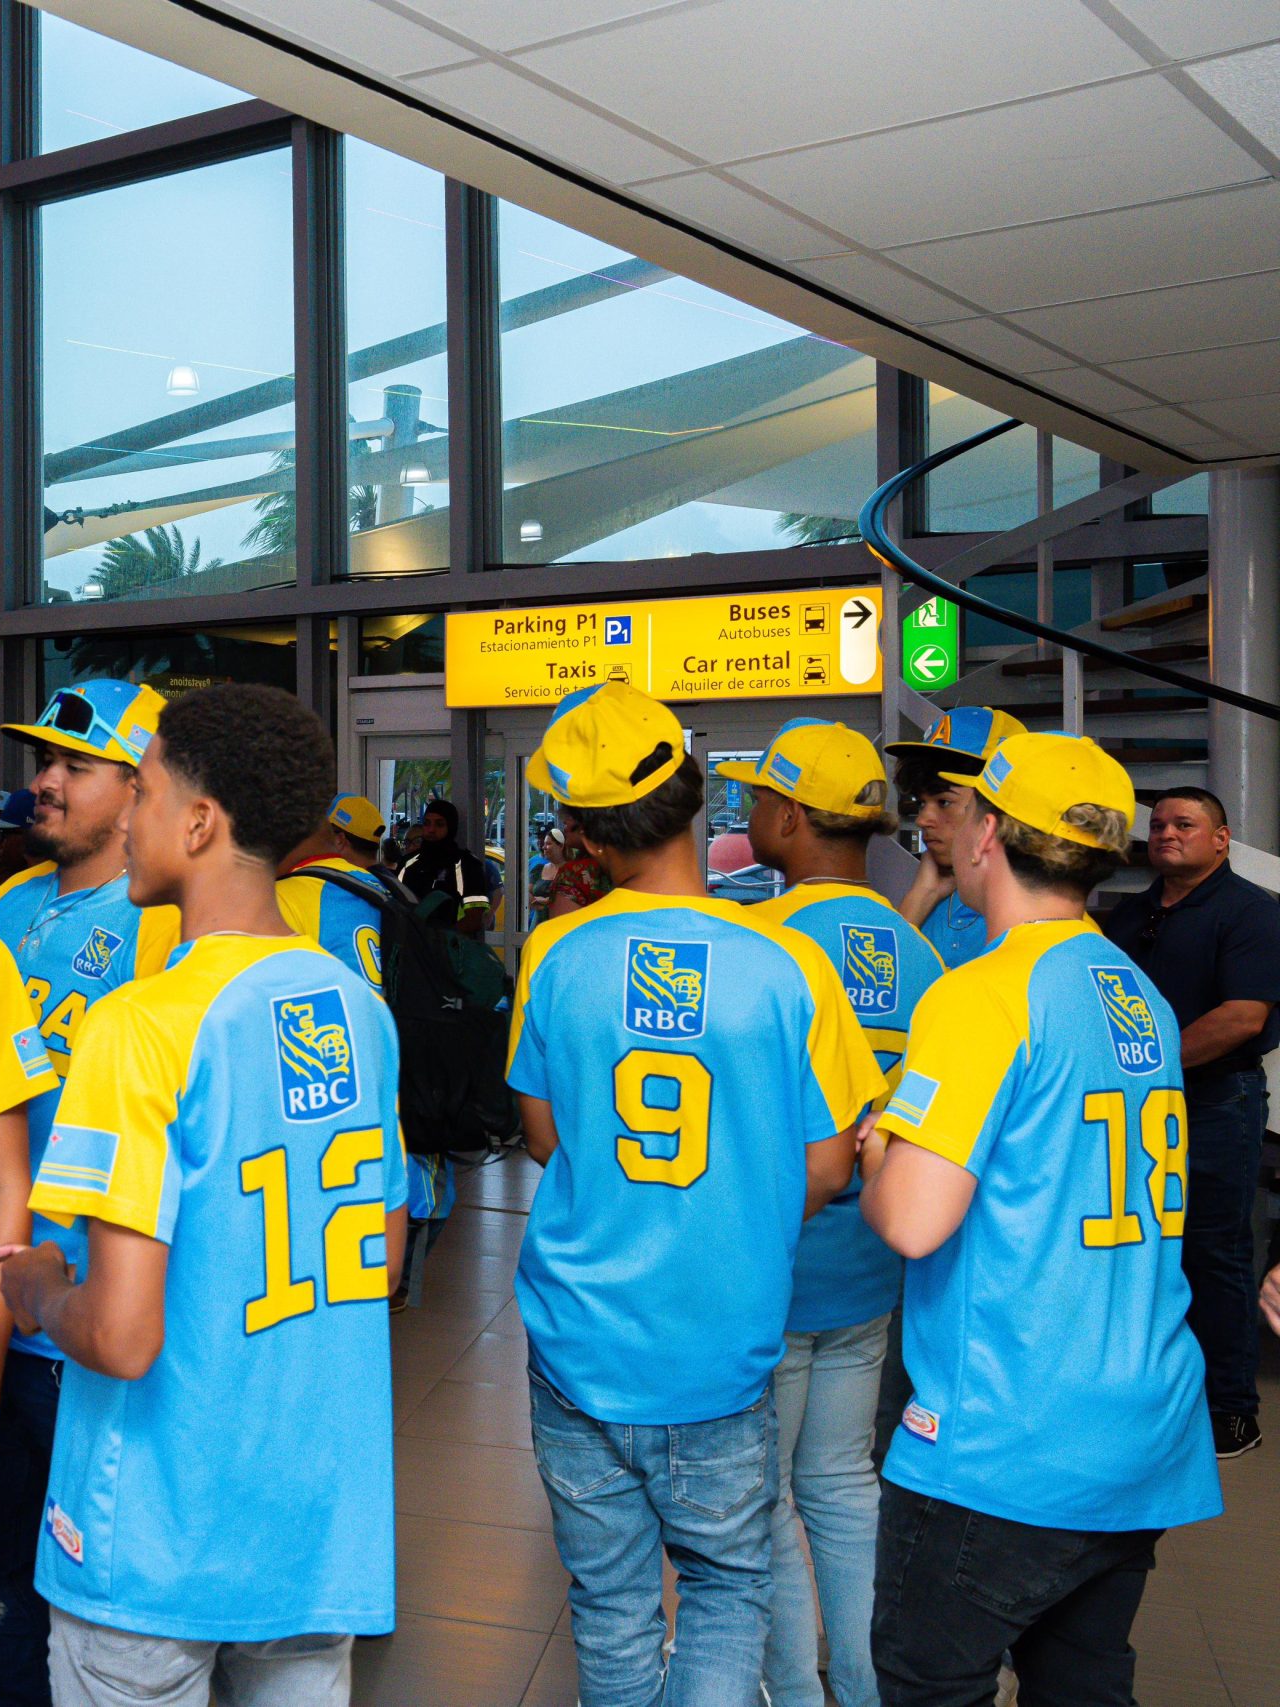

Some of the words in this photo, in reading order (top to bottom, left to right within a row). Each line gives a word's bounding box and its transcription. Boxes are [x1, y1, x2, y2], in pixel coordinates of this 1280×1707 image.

[494, 615, 566, 636] Parking
[577, 613, 597, 630] P1
[730, 604, 791, 622] Buses
[480, 637, 579, 653] Estacionamiento
[583, 635, 597, 648] P1
[718, 626, 791, 641] Autobuses
[546, 660, 597, 679] Taxis
[683, 655, 718, 674] Car
[726, 650, 790, 672] rental
[504, 685, 551, 699] Servicio
[554, 683, 570, 697] de
[670, 678, 724, 694] Alquiler
[728, 677, 745, 690] de
[749, 677, 791, 690] carros
[927, 714, 951, 745] A
[75, 958, 102, 977] RBC
[846, 987, 891, 1009] RBC
[24, 974, 88, 1050] BA
[634, 1007, 697, 1033] RBC
[1118, 1041, 1159, 1066] RBC
[287, 1077, 351, 1115] RBC
[611, 1046, 714, 1191] 9
[1079, 1085, 1190, 1250] 18
[238, 1123, 390, 1338] 12
